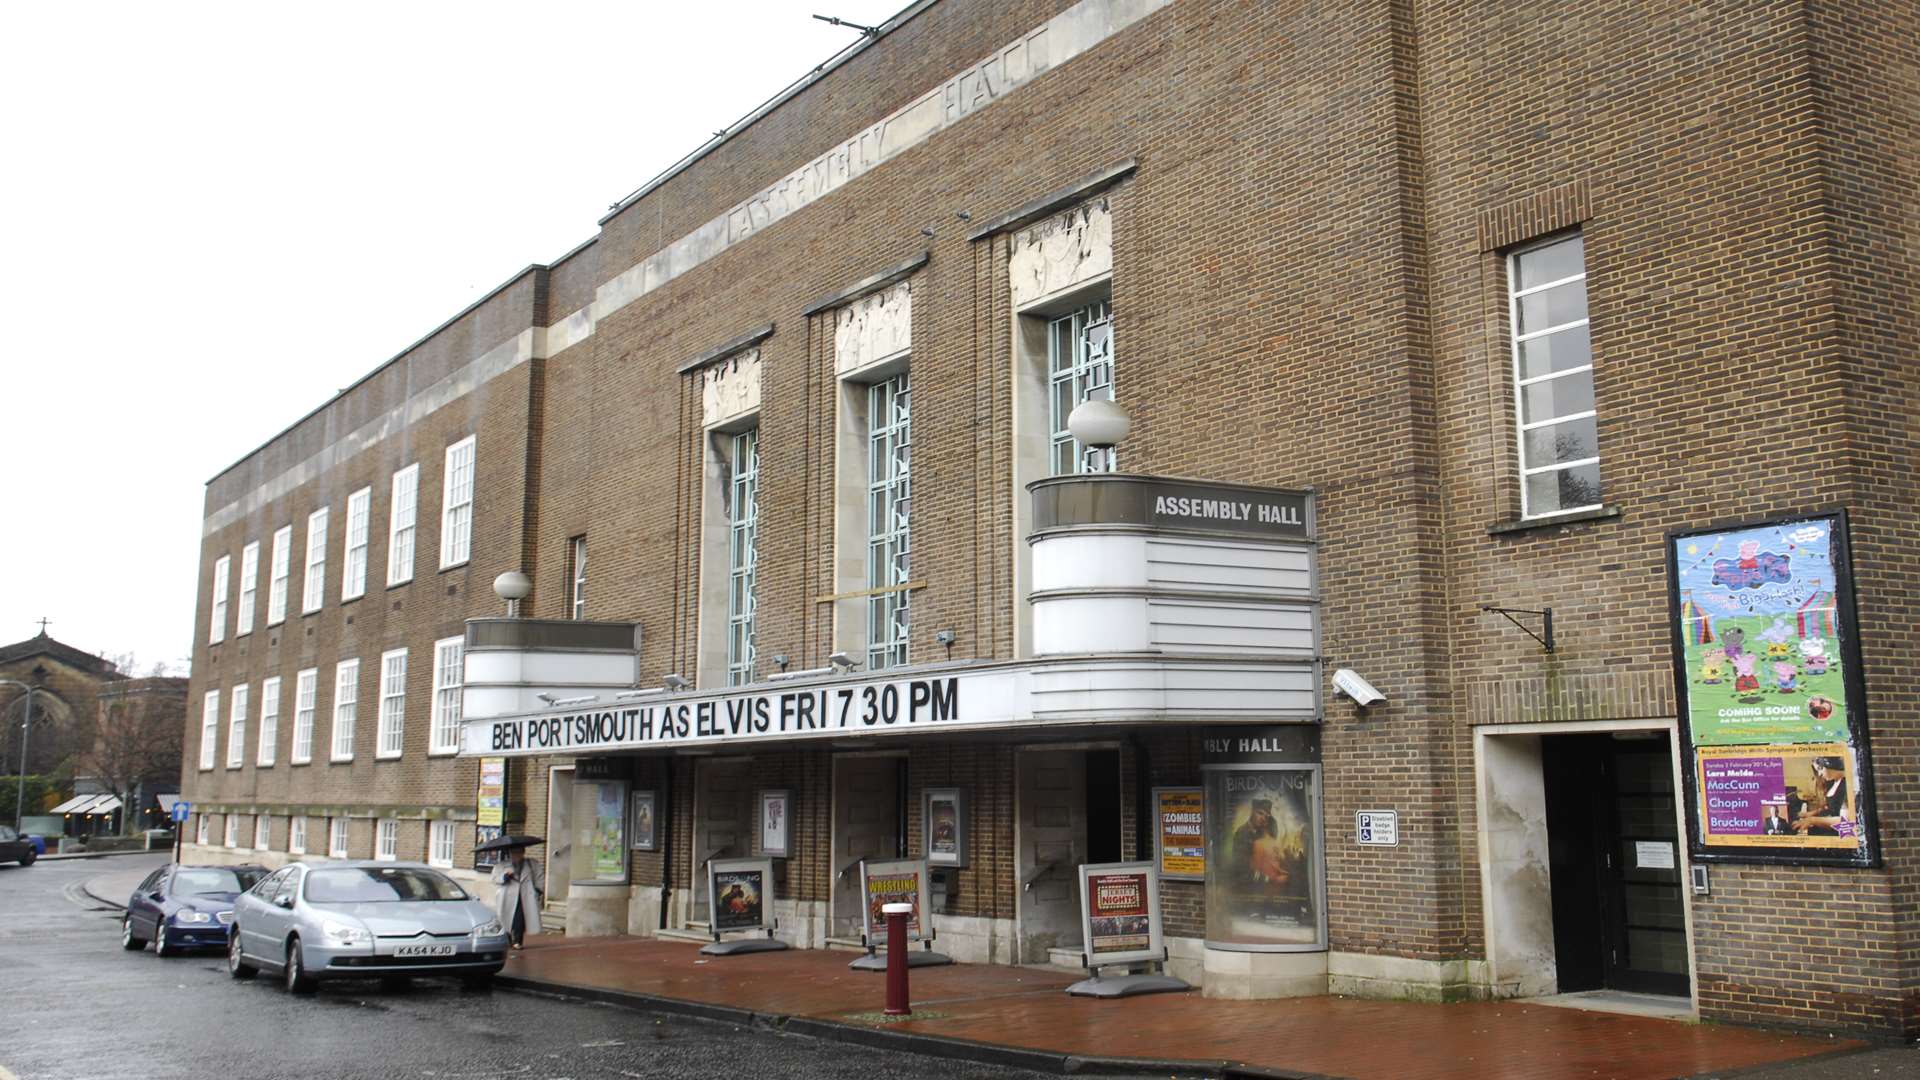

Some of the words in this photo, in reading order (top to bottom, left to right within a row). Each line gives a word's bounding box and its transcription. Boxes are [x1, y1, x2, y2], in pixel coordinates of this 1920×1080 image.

[729, 122, 888, 243] ASSEMBLY
[941, 33, 1048, 126] HALL
[1155, 496, 1251, 521] ASSEMBLY
[1258, 504, 1302, 525] HALL
[492, 721, 523, 750] BEN
[528, 708, 653, 748] PORTSMOUTH
[660, 704, 690, 739] AS
[697, 697, 769, 737] ELVIS
[780, 689, 827, 731] FRI
[909, 677, 959, 723] PM
[1718, 707, 1762, 717] COMING
[1765, 705, 1800, 715] SOON!
[1203, 738, 1231, 753] BLY
[1239, 738, 1283, 753] HALL
[1707, 780, 1760, 790] MacCunn
[1709, 797, 1749, 810] Chopin
[1165, 812, 1202, 823] ZOMBIES
[1711, 816, 1759, 828] Bruckner
[1171, 825, 1201, 835] ANIMALS
[1102, 895, 1136, 905] NIGHTS
[399, 946, 428, 955] KA54
